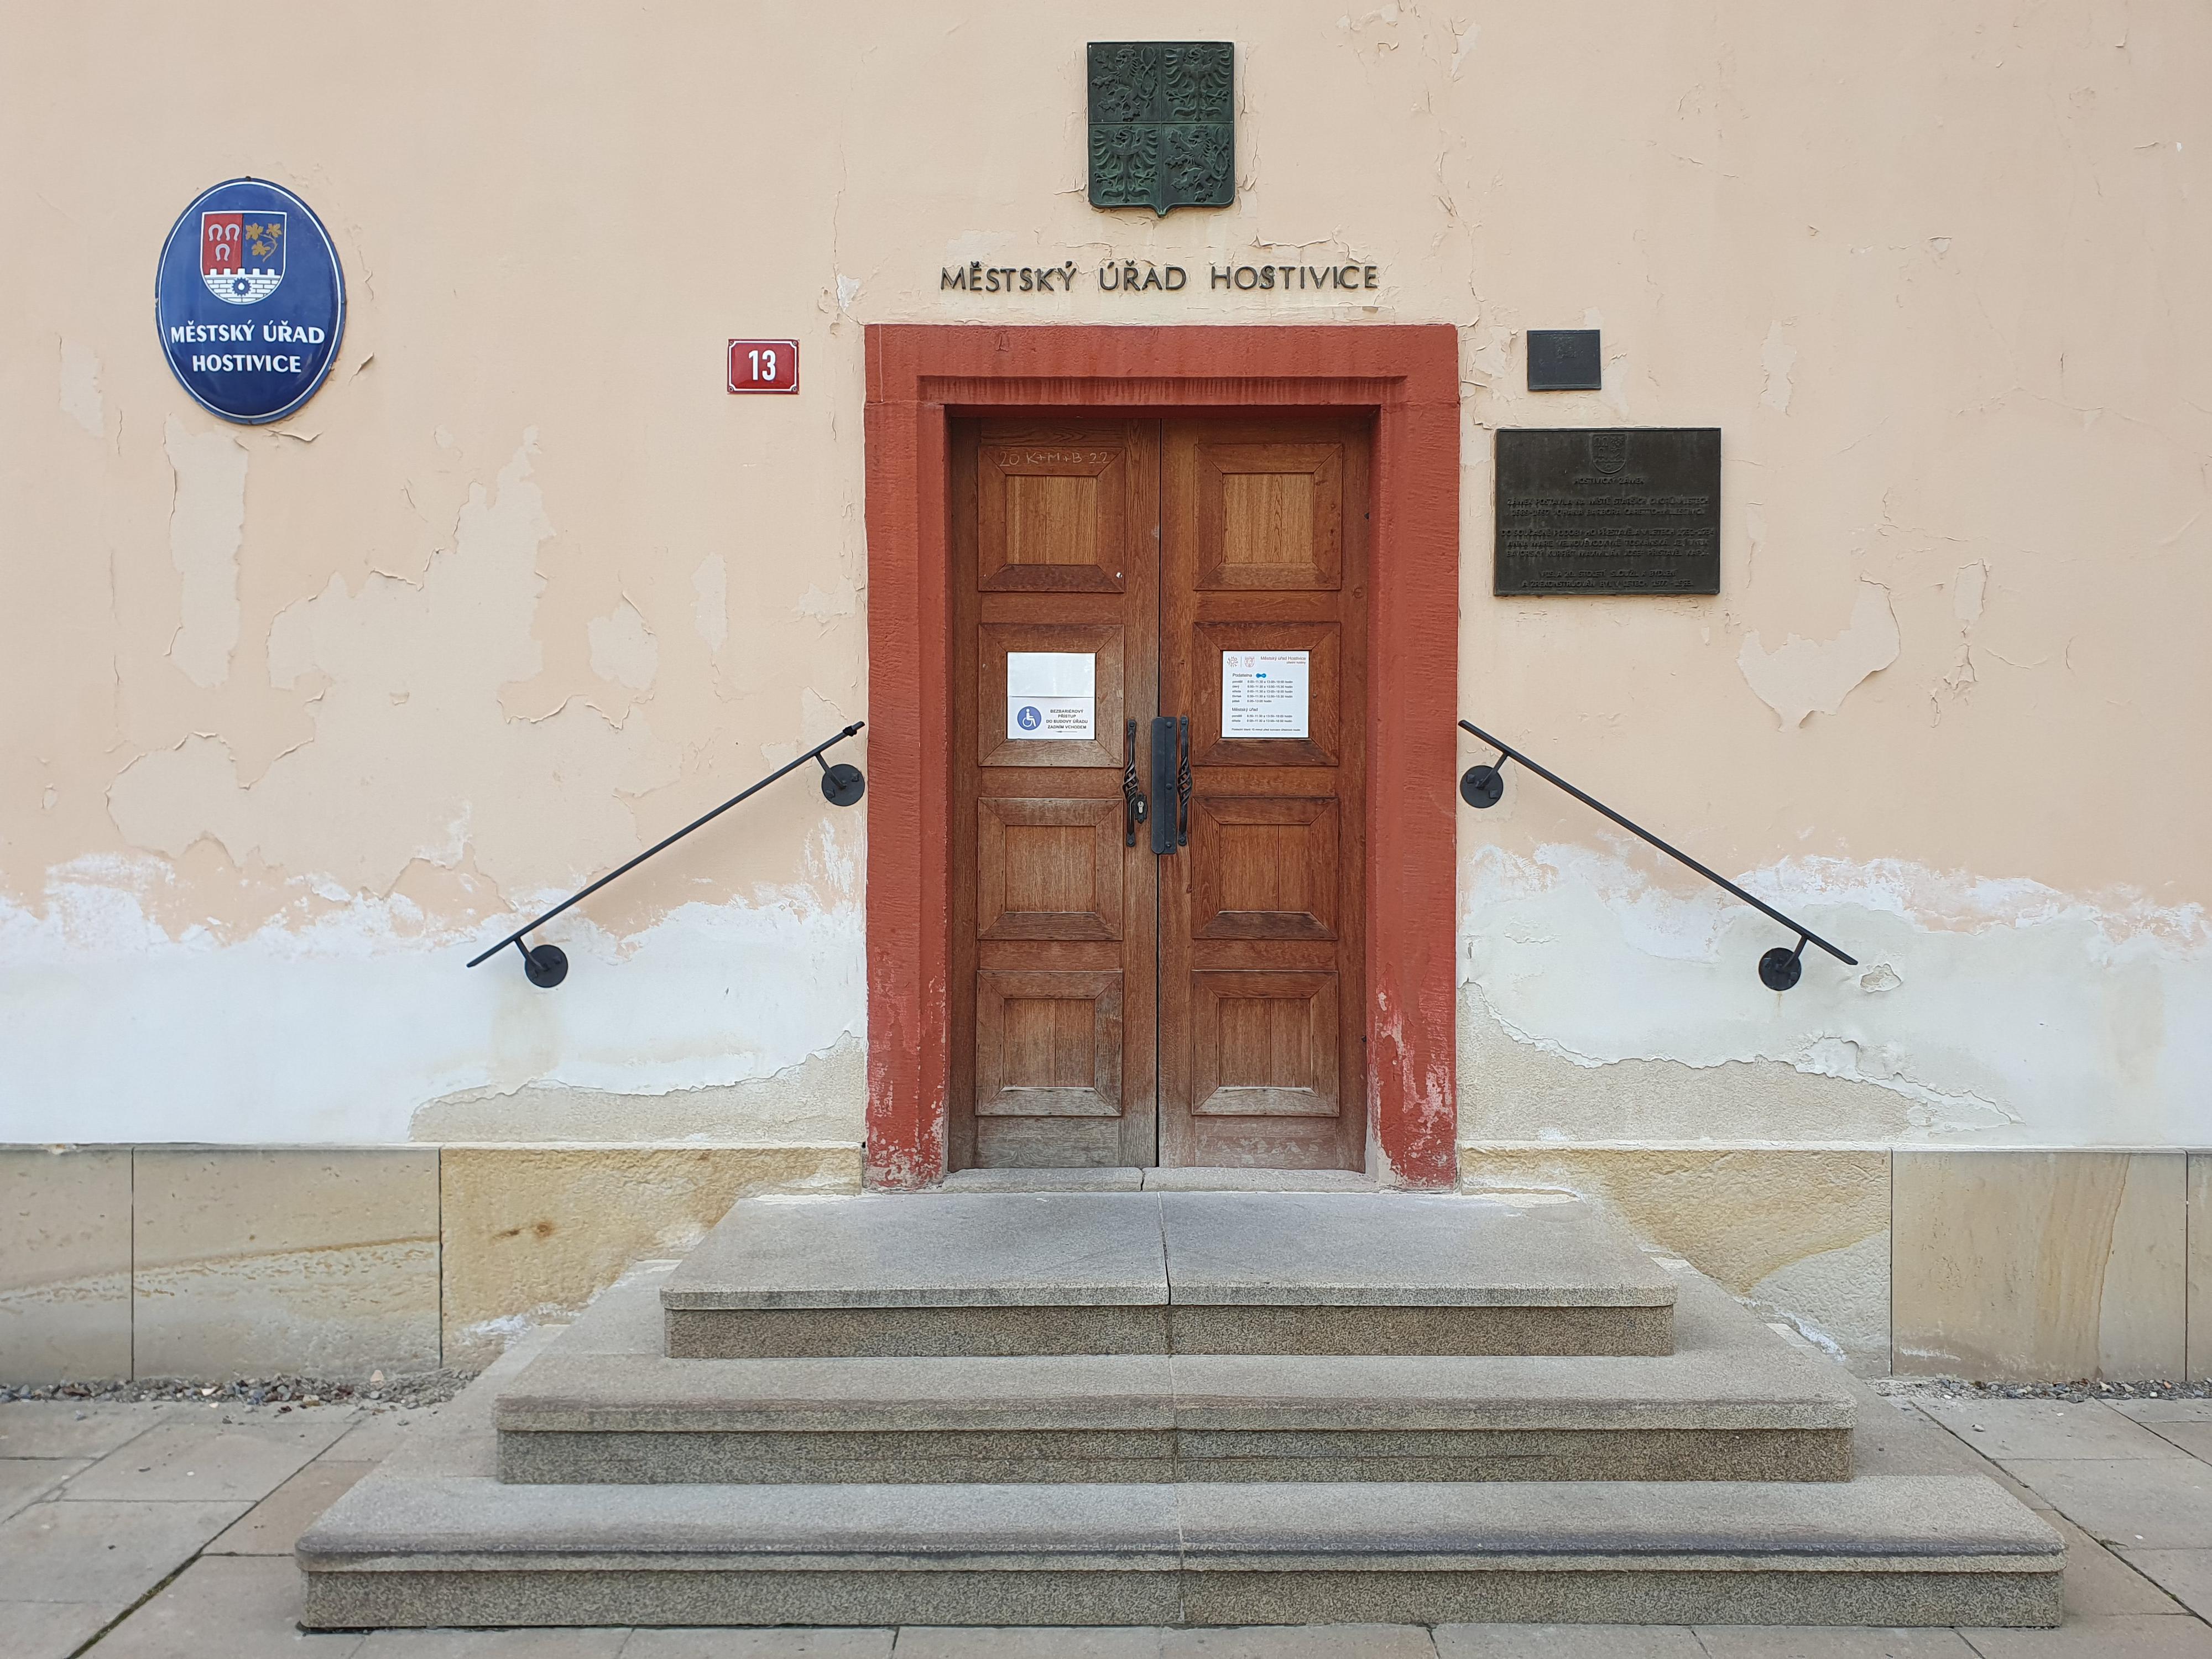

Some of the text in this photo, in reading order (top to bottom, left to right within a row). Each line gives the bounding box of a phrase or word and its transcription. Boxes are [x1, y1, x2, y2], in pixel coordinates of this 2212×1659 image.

[940, 260, 1379, 291] MĚSTSKÝ ÚŘAD HOSTIVICE
[171, 319, 325, 344] MĚSTSKÝ ÚŘAD
[192, 354, 302, 373] HOSTIVICE
[748, 349, 776, 380] 13
[999, 451, 1020, 467] 20
[1574, 475, 1645, 484] HOSTIVICKÝ ZÁMEK
